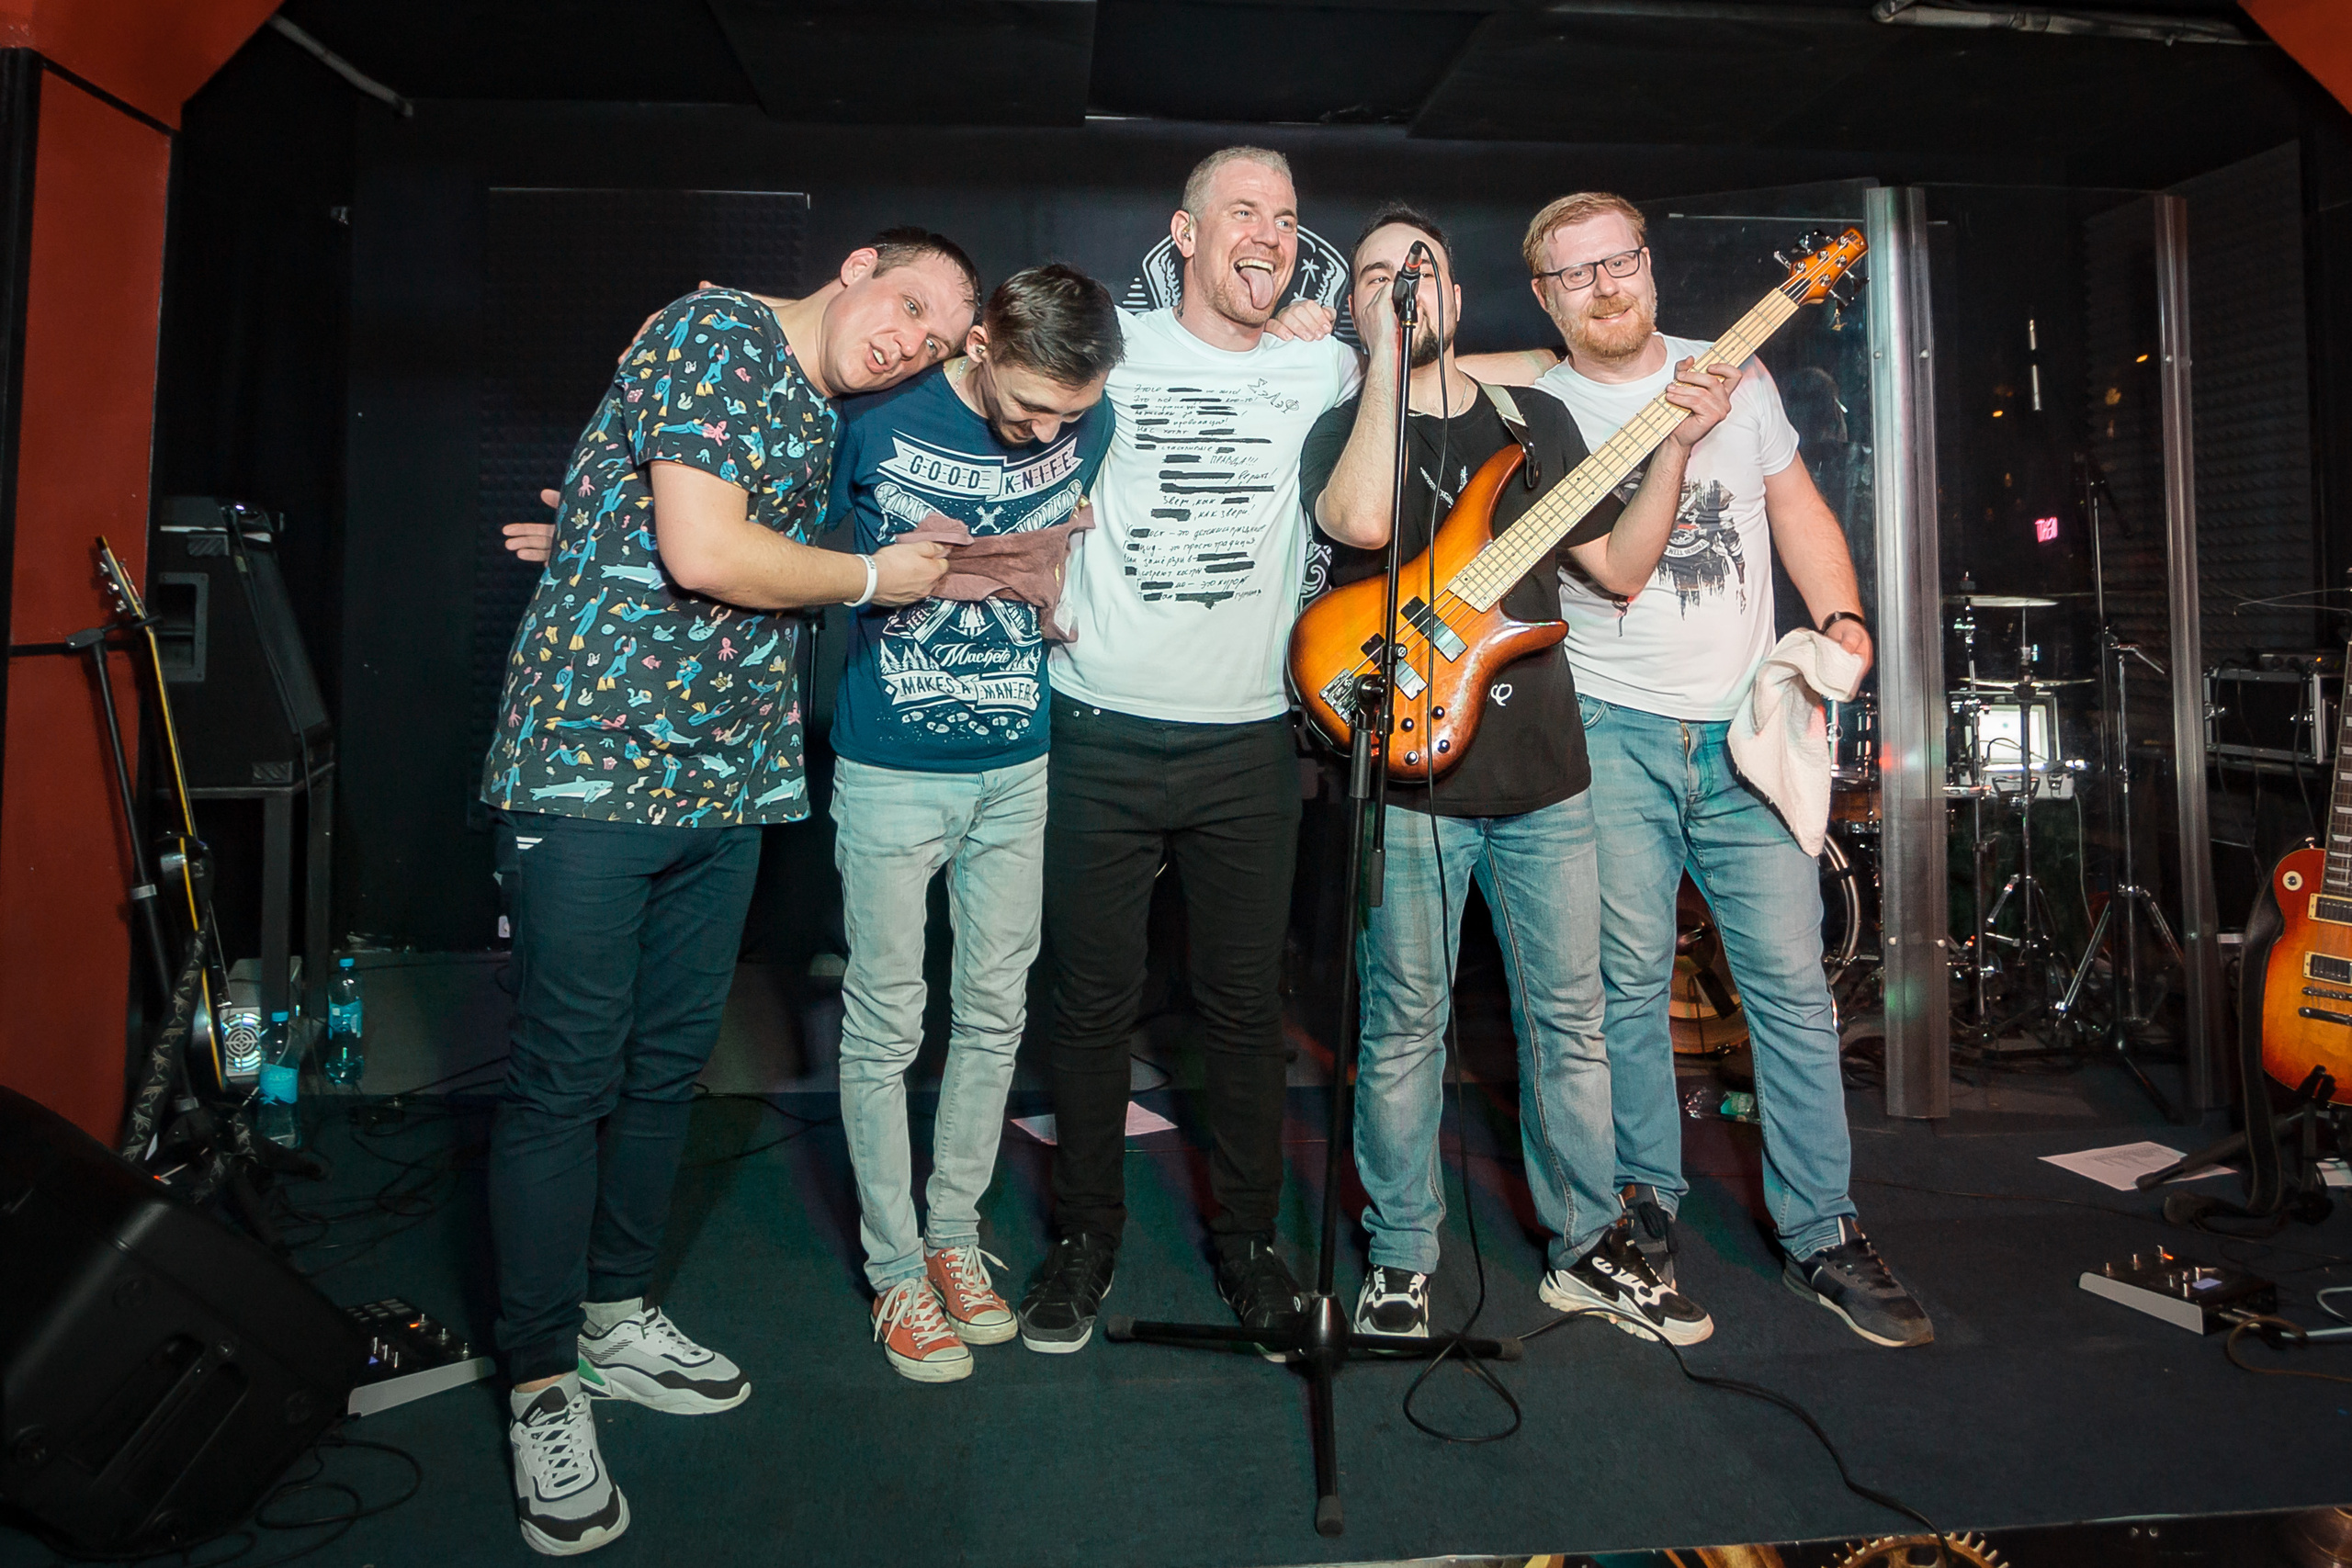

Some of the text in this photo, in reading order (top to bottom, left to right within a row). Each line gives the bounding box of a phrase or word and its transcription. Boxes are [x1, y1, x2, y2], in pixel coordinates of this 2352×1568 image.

[910, 451, 1072, 495] GOOD KNIFE
[930, 642, 1012, 669] Machete
[900, 676, 956, 695] MAKES
